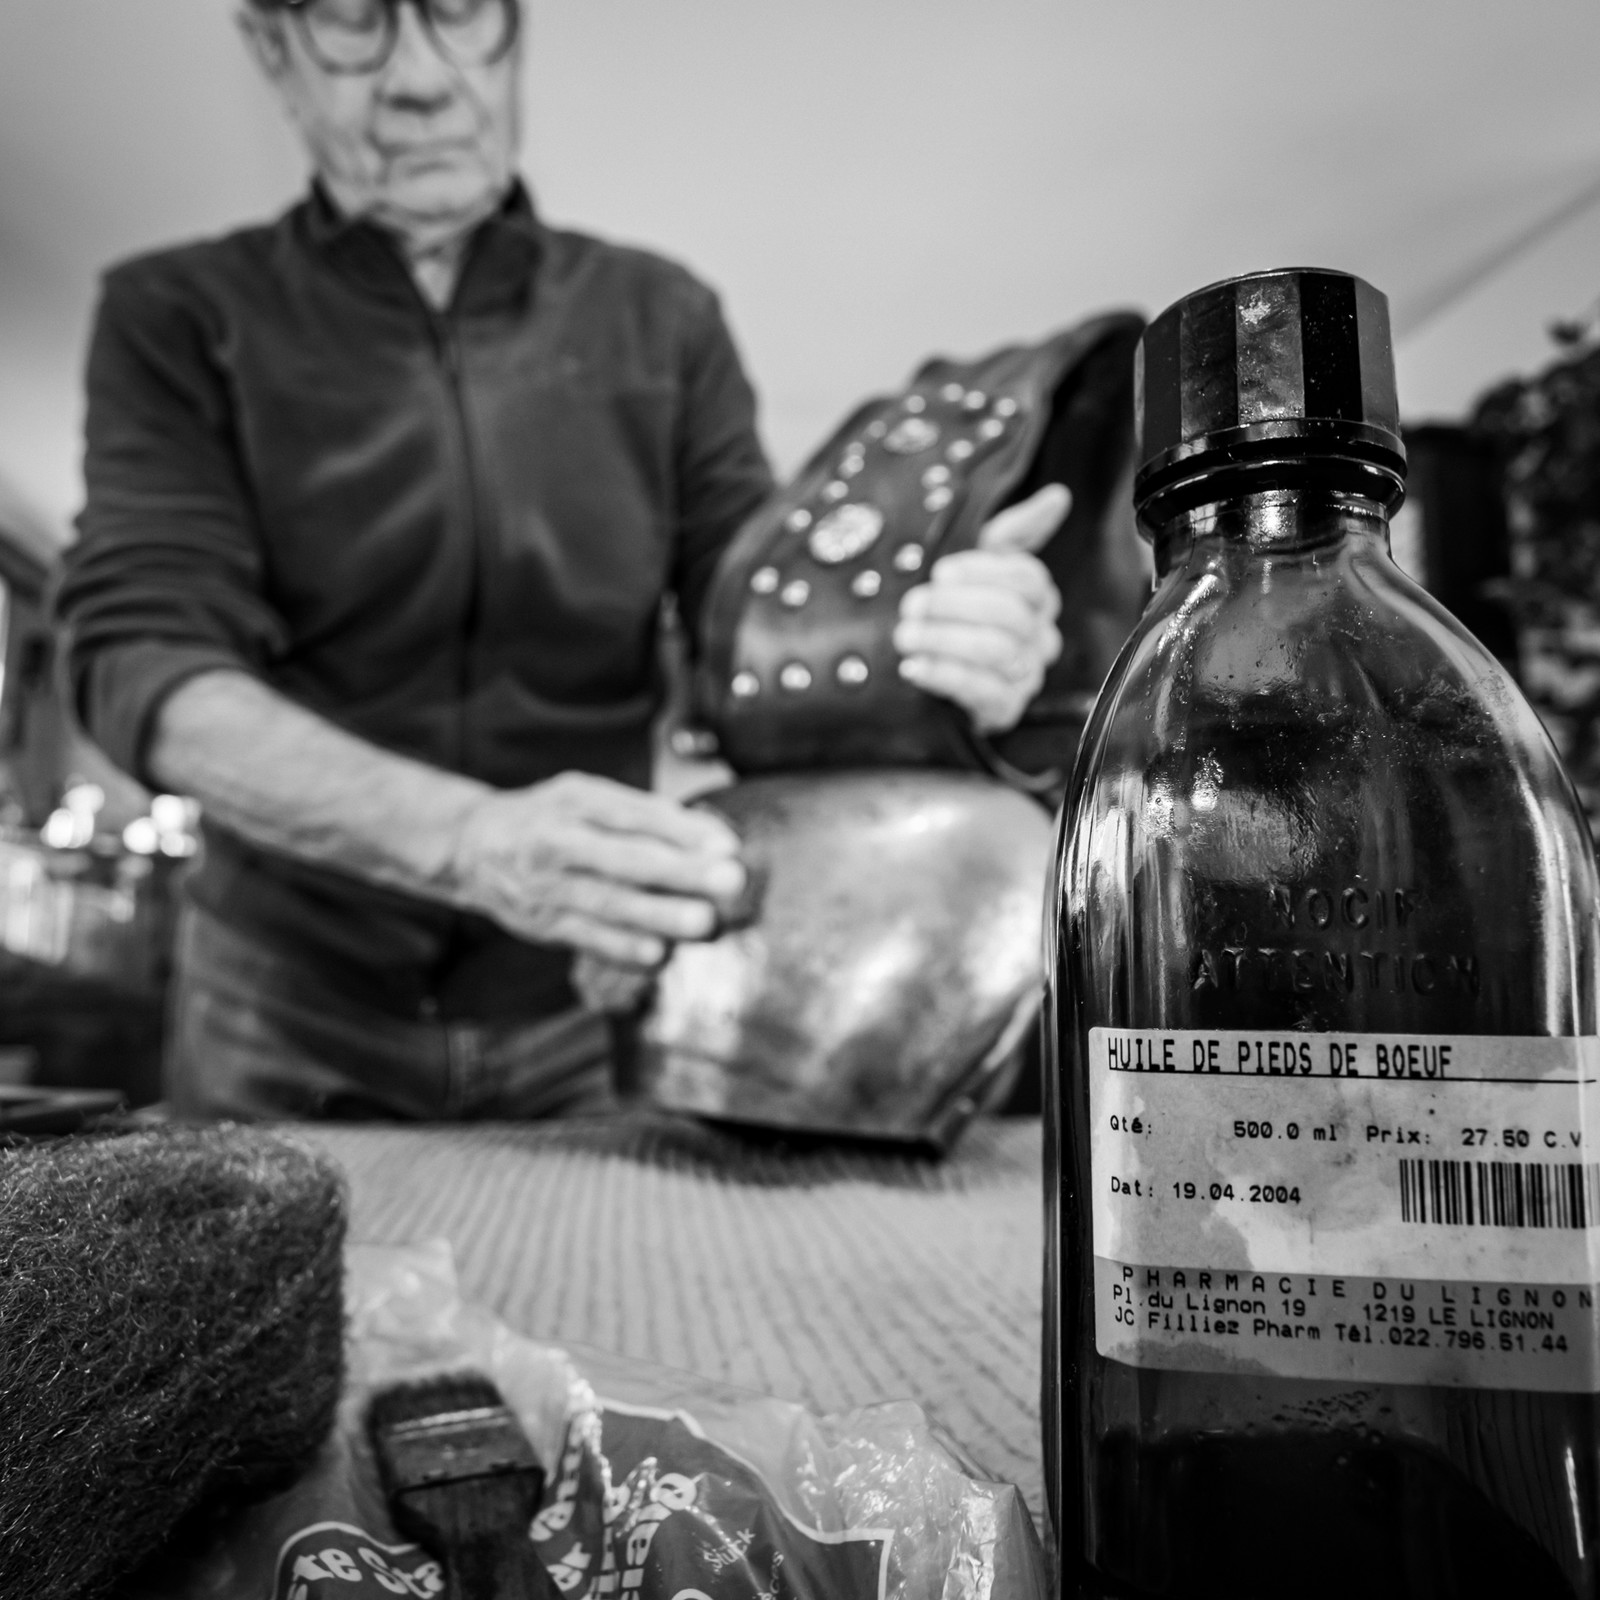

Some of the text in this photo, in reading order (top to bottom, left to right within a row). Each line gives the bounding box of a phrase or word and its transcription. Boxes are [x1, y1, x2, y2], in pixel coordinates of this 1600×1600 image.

[1190, 948, 1480, 995] ATTENTION
[1107, 1036, 1452, 1080] HUILE DE PIEDS DE BOEUF
[1110, 1114, 1153, 1135] Qté:
[1233, 1120, 1300, 1140] 500.0
[1312, 1124, 1338, 1142] ml
[1365, 1124, 1431, 1145] Prix:
[1461, 1127, 1531, 1148] 27.50
[1110, 1175, 1302, 1205] Dat: 19.04.2004
[1114, 1305, 1136, 1327] JC
[1147, 1310, 1240, 1336] Filliez
[1253, 1317, 1321, 1341] Pharm
[1186, 1292, 1267, 1315] Lignon
[1281, 1298, 1307, 1318] 19
[1363, 1303, 1416, 1324] 1219
[1428, 1306, 1458, 1327] LE
[1470, 1308, 1555, 1331] LIGNON
